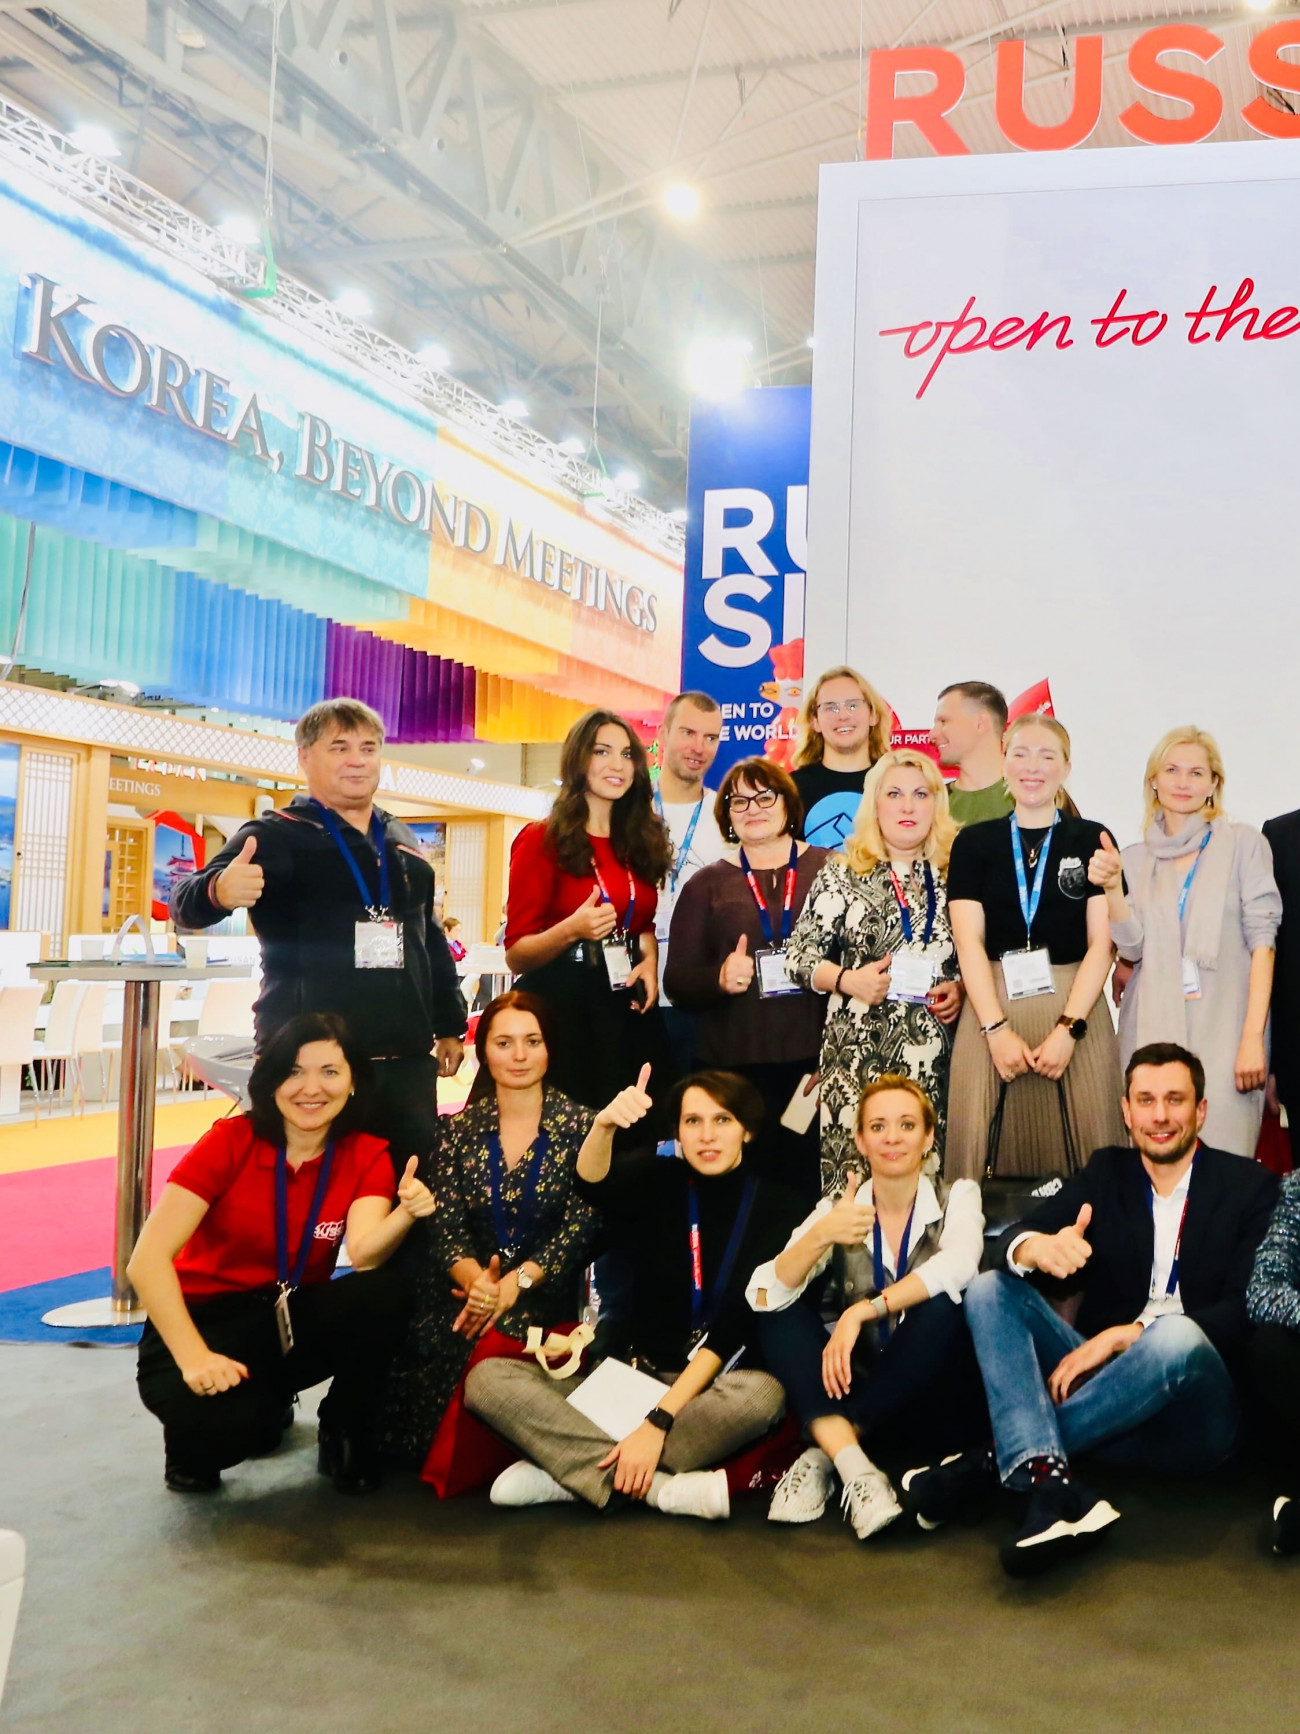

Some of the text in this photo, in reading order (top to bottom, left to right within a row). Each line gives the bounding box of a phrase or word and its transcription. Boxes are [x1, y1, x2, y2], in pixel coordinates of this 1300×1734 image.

[879, 297, 1074, 400] open
[1090, 289, 1167, 348] to
[19, 272, 658, 633] KOREA, BEYOND MEETINGS
[720, 702, 774, 719] EN TO
[734, 725, 801, 741] WORLD
[109, 777, 161, 797] EETINGS
